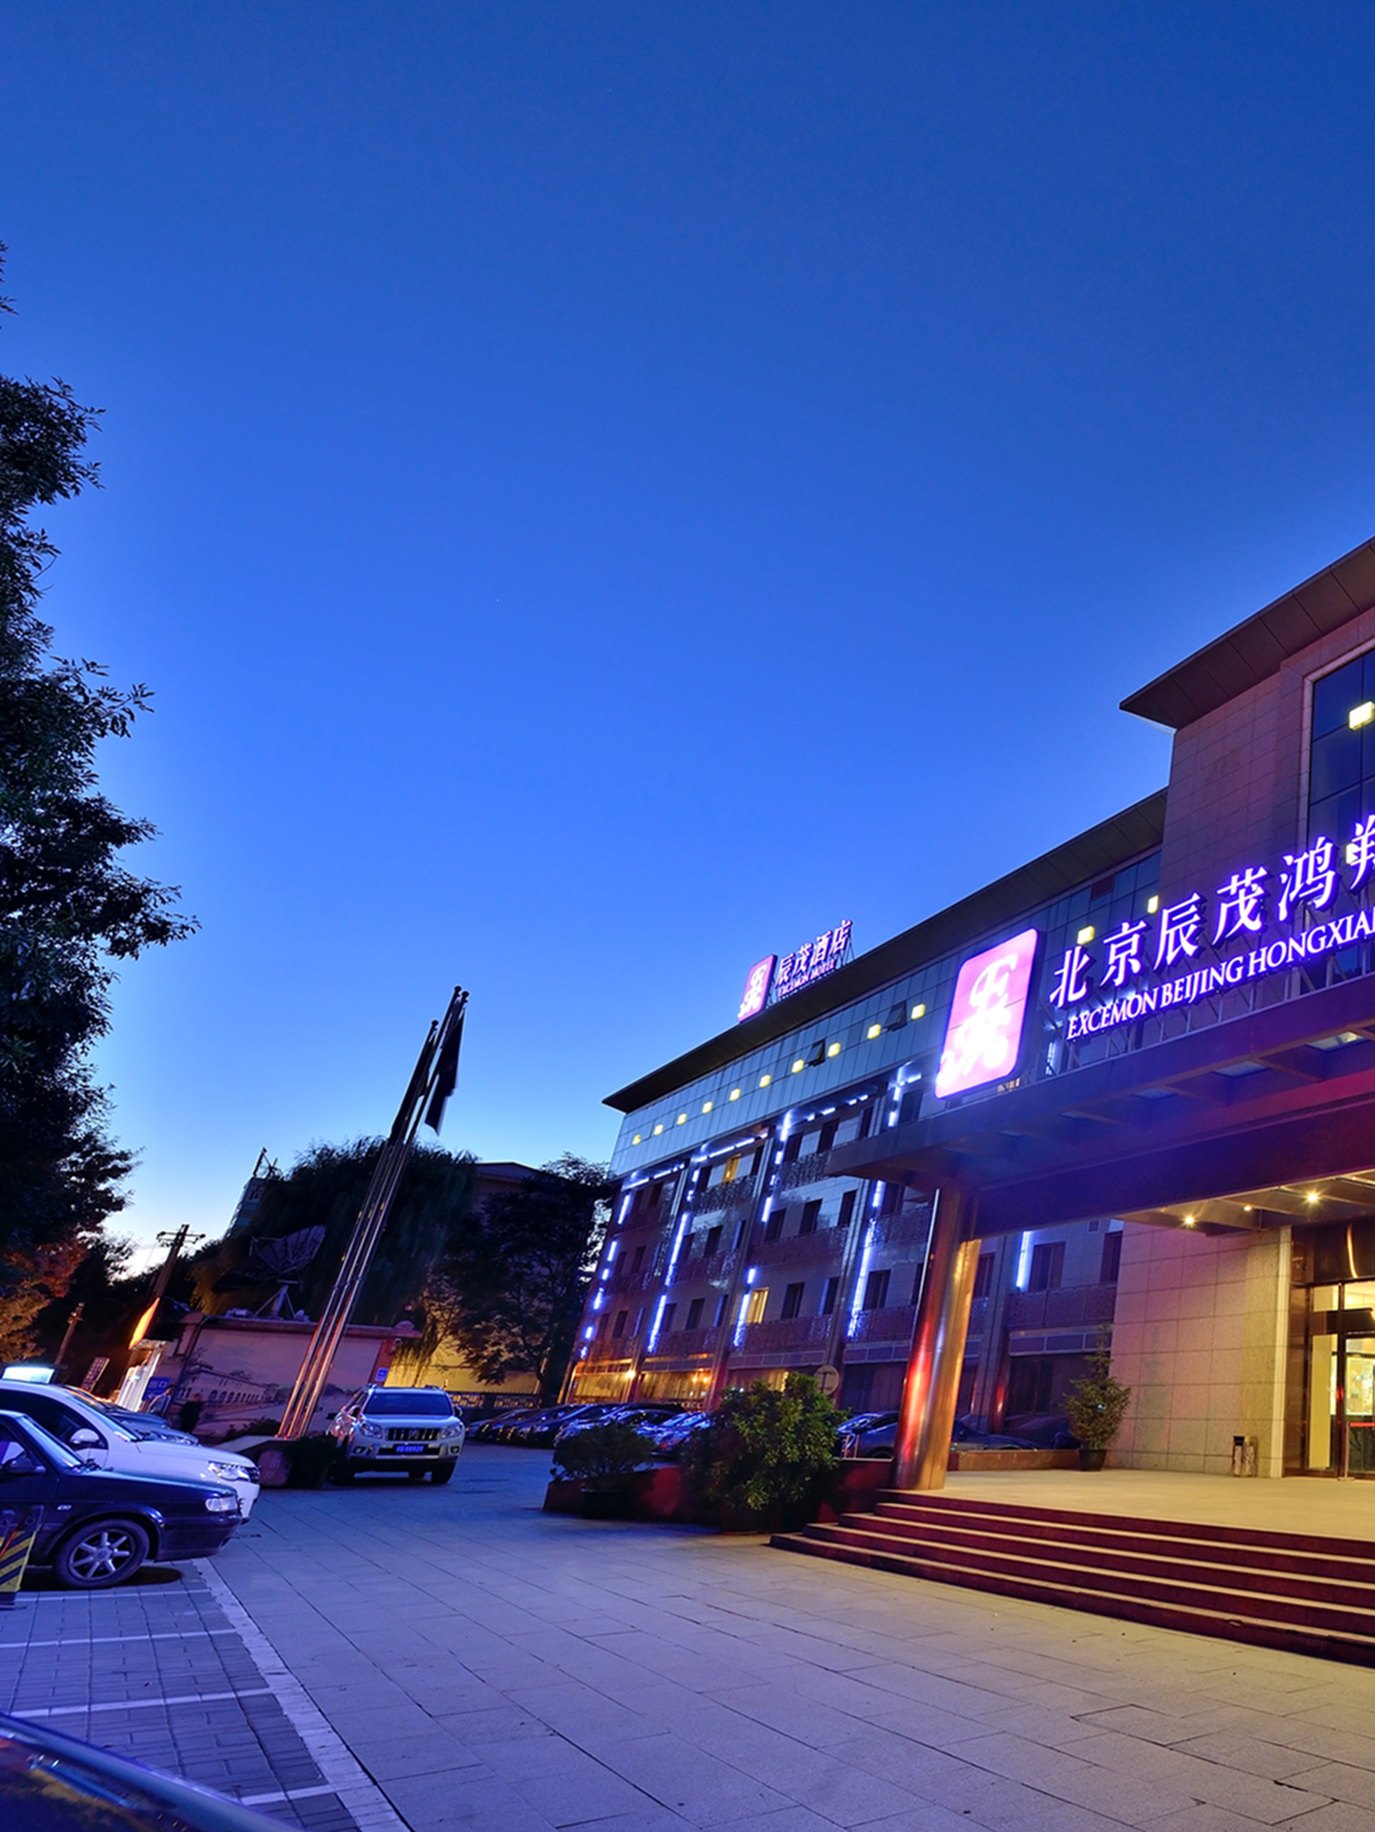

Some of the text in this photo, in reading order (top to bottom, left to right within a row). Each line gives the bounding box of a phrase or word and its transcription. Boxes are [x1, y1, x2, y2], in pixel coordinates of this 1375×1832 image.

[776, 919, 852, 988] 辰茂酒店
[1066, 987, 1159, 1040] EXCEMON
[1159, 956, 1244, 1008] BEIJING
